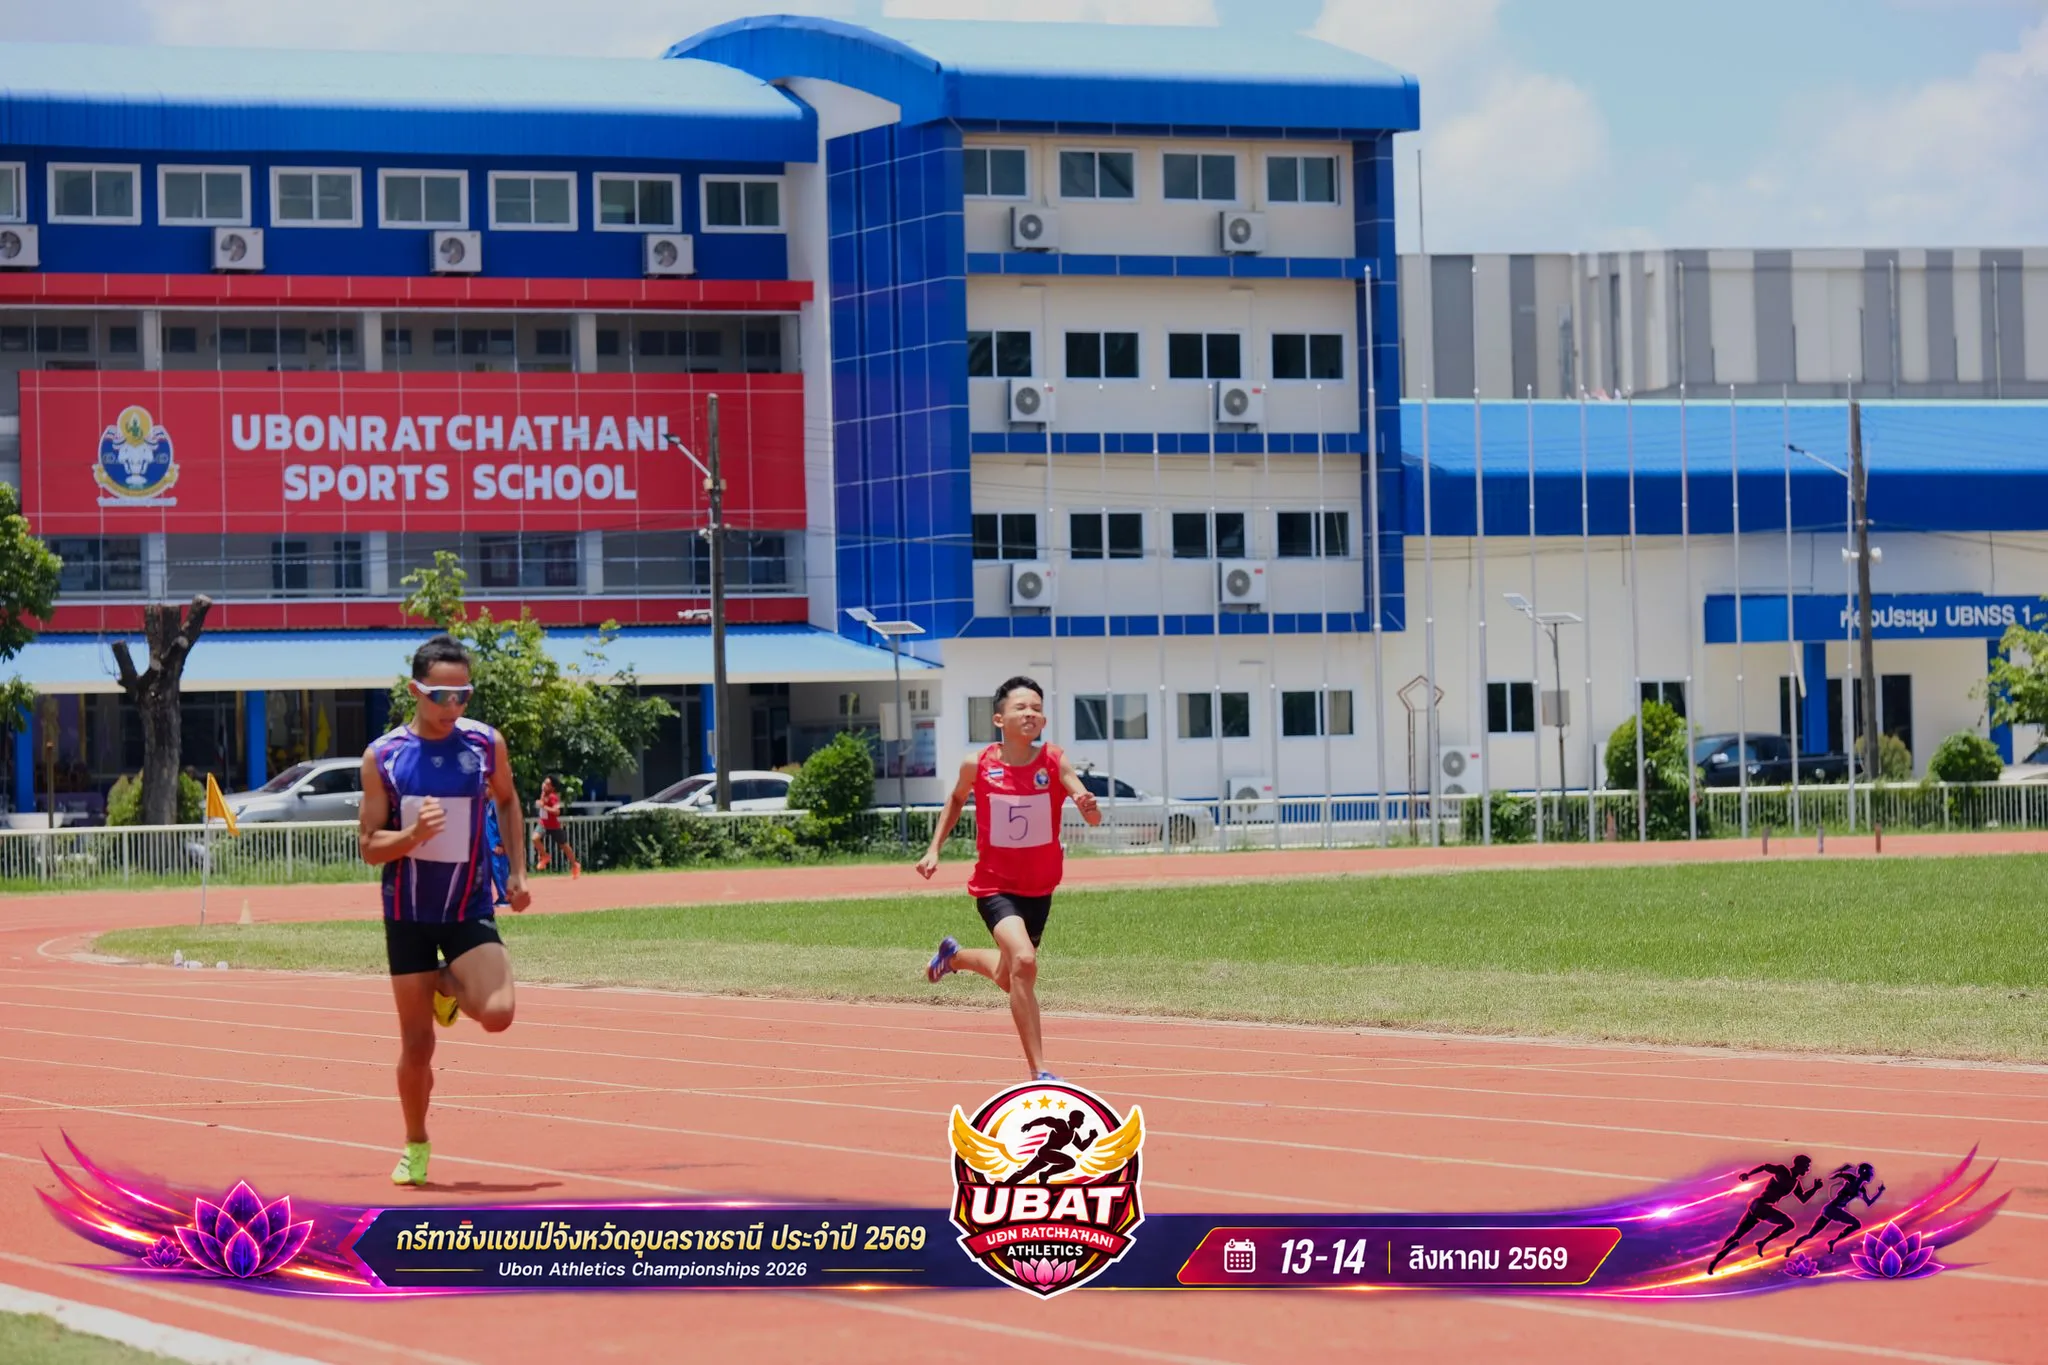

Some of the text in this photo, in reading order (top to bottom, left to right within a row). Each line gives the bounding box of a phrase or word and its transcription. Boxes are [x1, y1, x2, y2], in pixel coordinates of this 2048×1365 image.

[231, 414, 669, 451] UBONRATCHATHANI
[283, 464, 637, 500] SPORTS SCHOOL
[1945, 604, 2016, 627] UBNSS
[1009, 805, 1032, 841] 5
